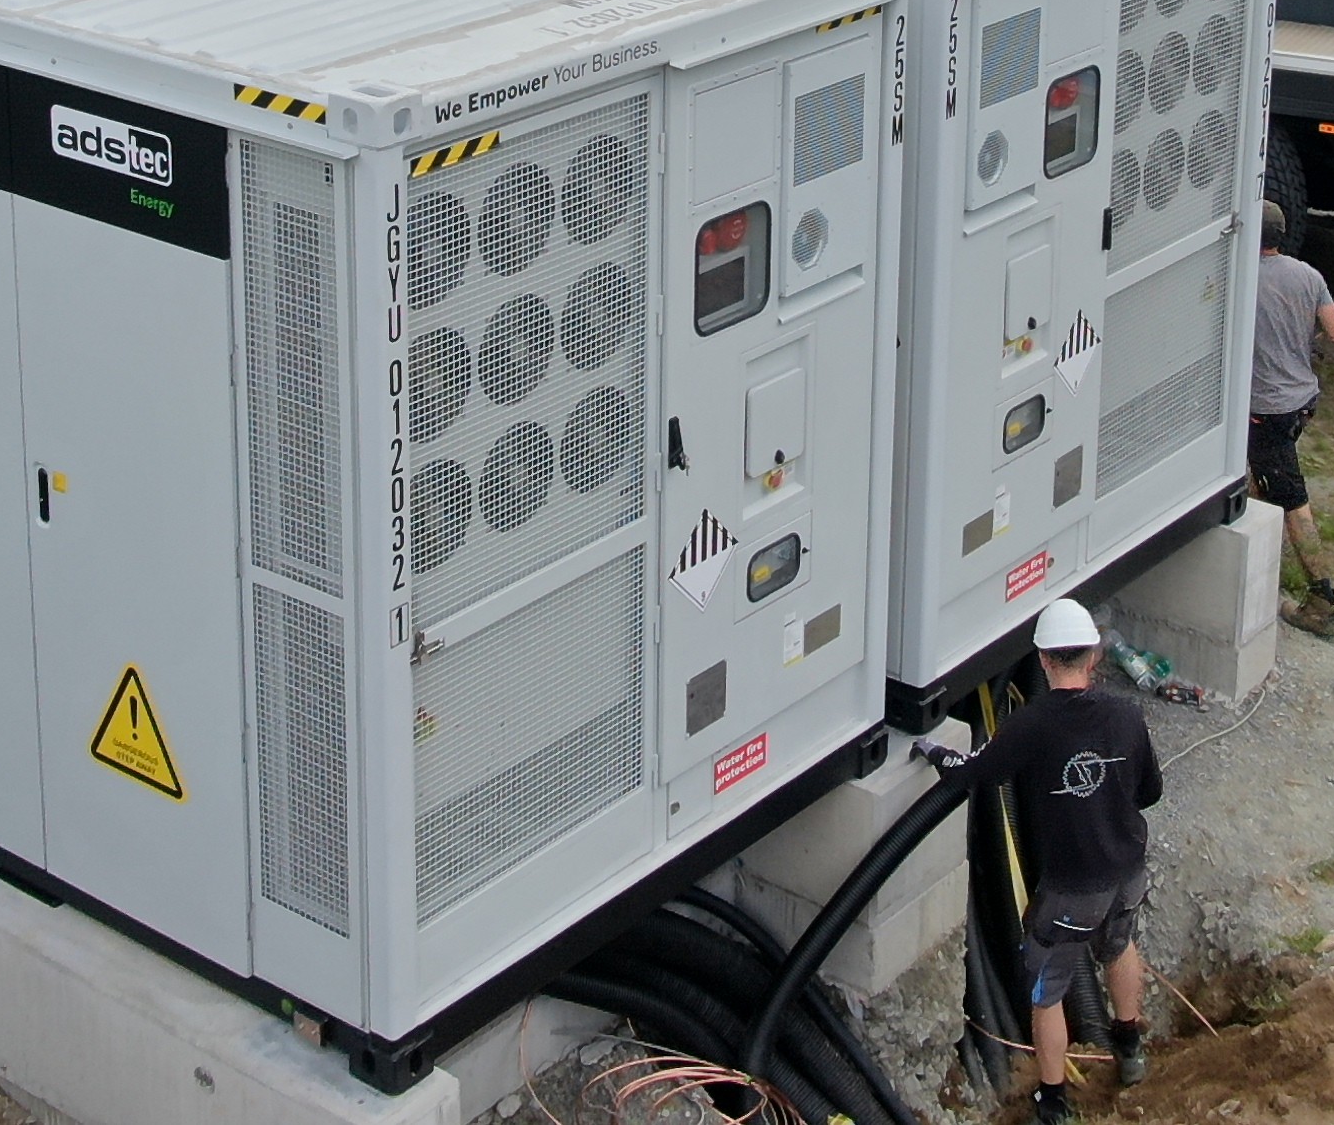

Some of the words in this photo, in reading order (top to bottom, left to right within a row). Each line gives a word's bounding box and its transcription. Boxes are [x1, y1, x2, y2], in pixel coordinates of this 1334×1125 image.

[435, 103, 463, 124] We
[468, 75, 549, 114] Empower
[553, 60, 587, 86] Your
[891, 15, 905, 147] 25SM
[130, 187, 175, 218] Energy
[386, 183, 402, 343] JGYU
[388, 359, 407, 592] 012032
[1008, 565, 1030, 584] Water
[715, 751, 764, 791] protection
[716, 750, 745, 775] Water
[746, 741, 764, 757] fire
